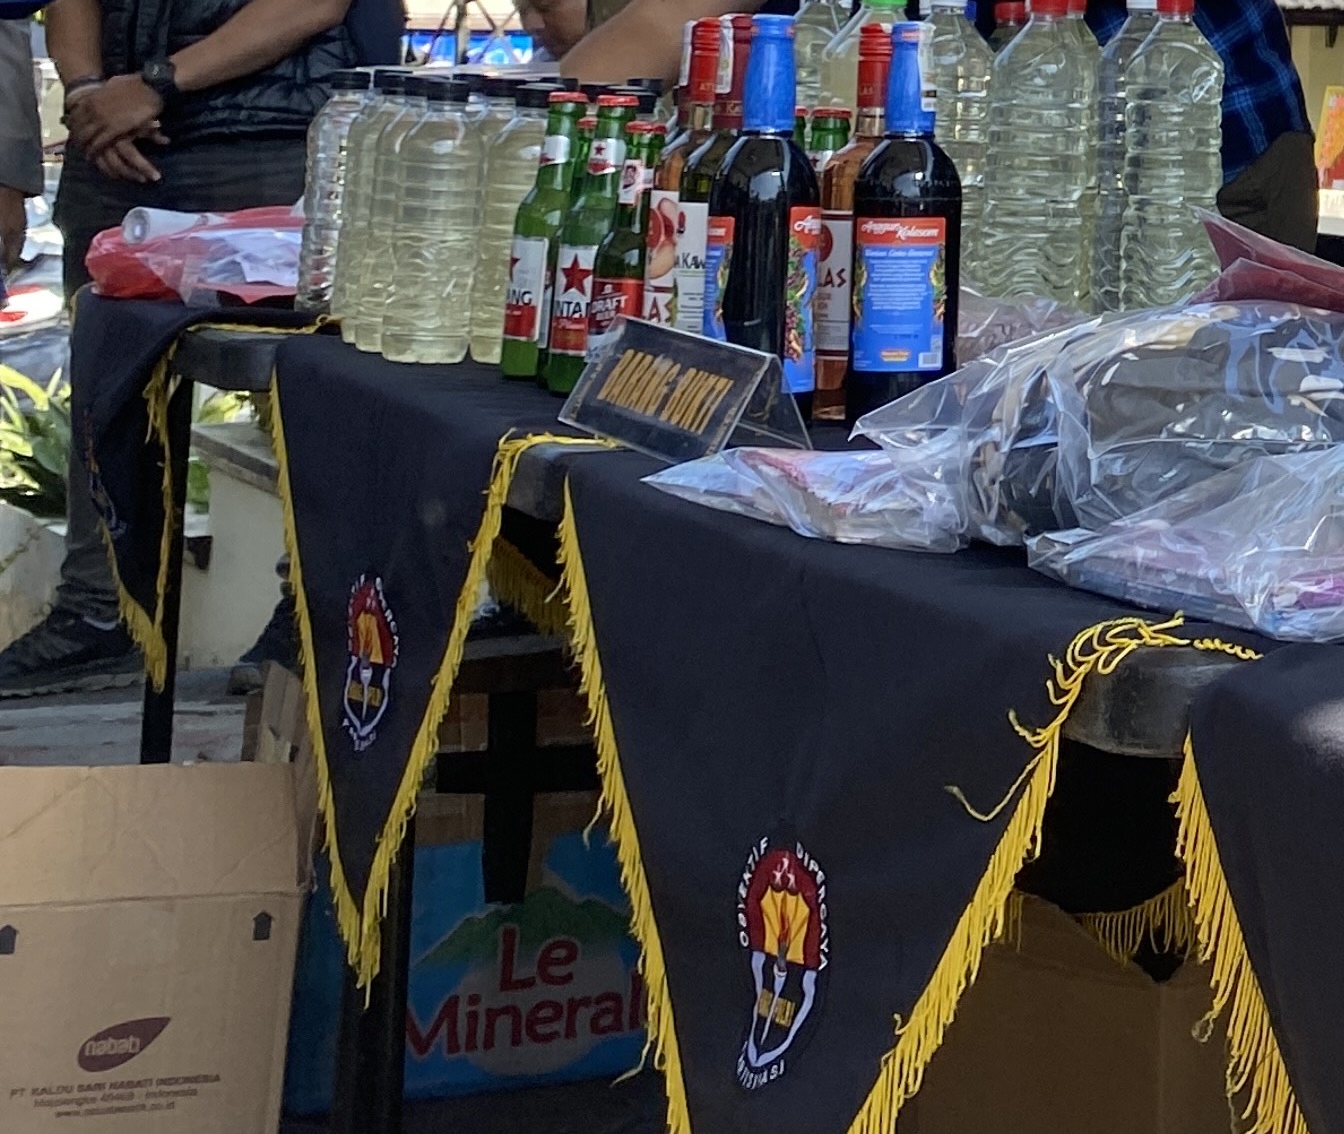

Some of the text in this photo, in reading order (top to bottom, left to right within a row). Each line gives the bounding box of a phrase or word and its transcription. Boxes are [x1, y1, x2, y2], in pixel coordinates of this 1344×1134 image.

[597, 349, 734, 435] BARANG BUKTI
[499, 925, 579, 992] Le
[84, 1035, 141, 1056] nabati
[406, 968, 649, 1057] Mineral
[10, 1087, 26, 1098] PT
